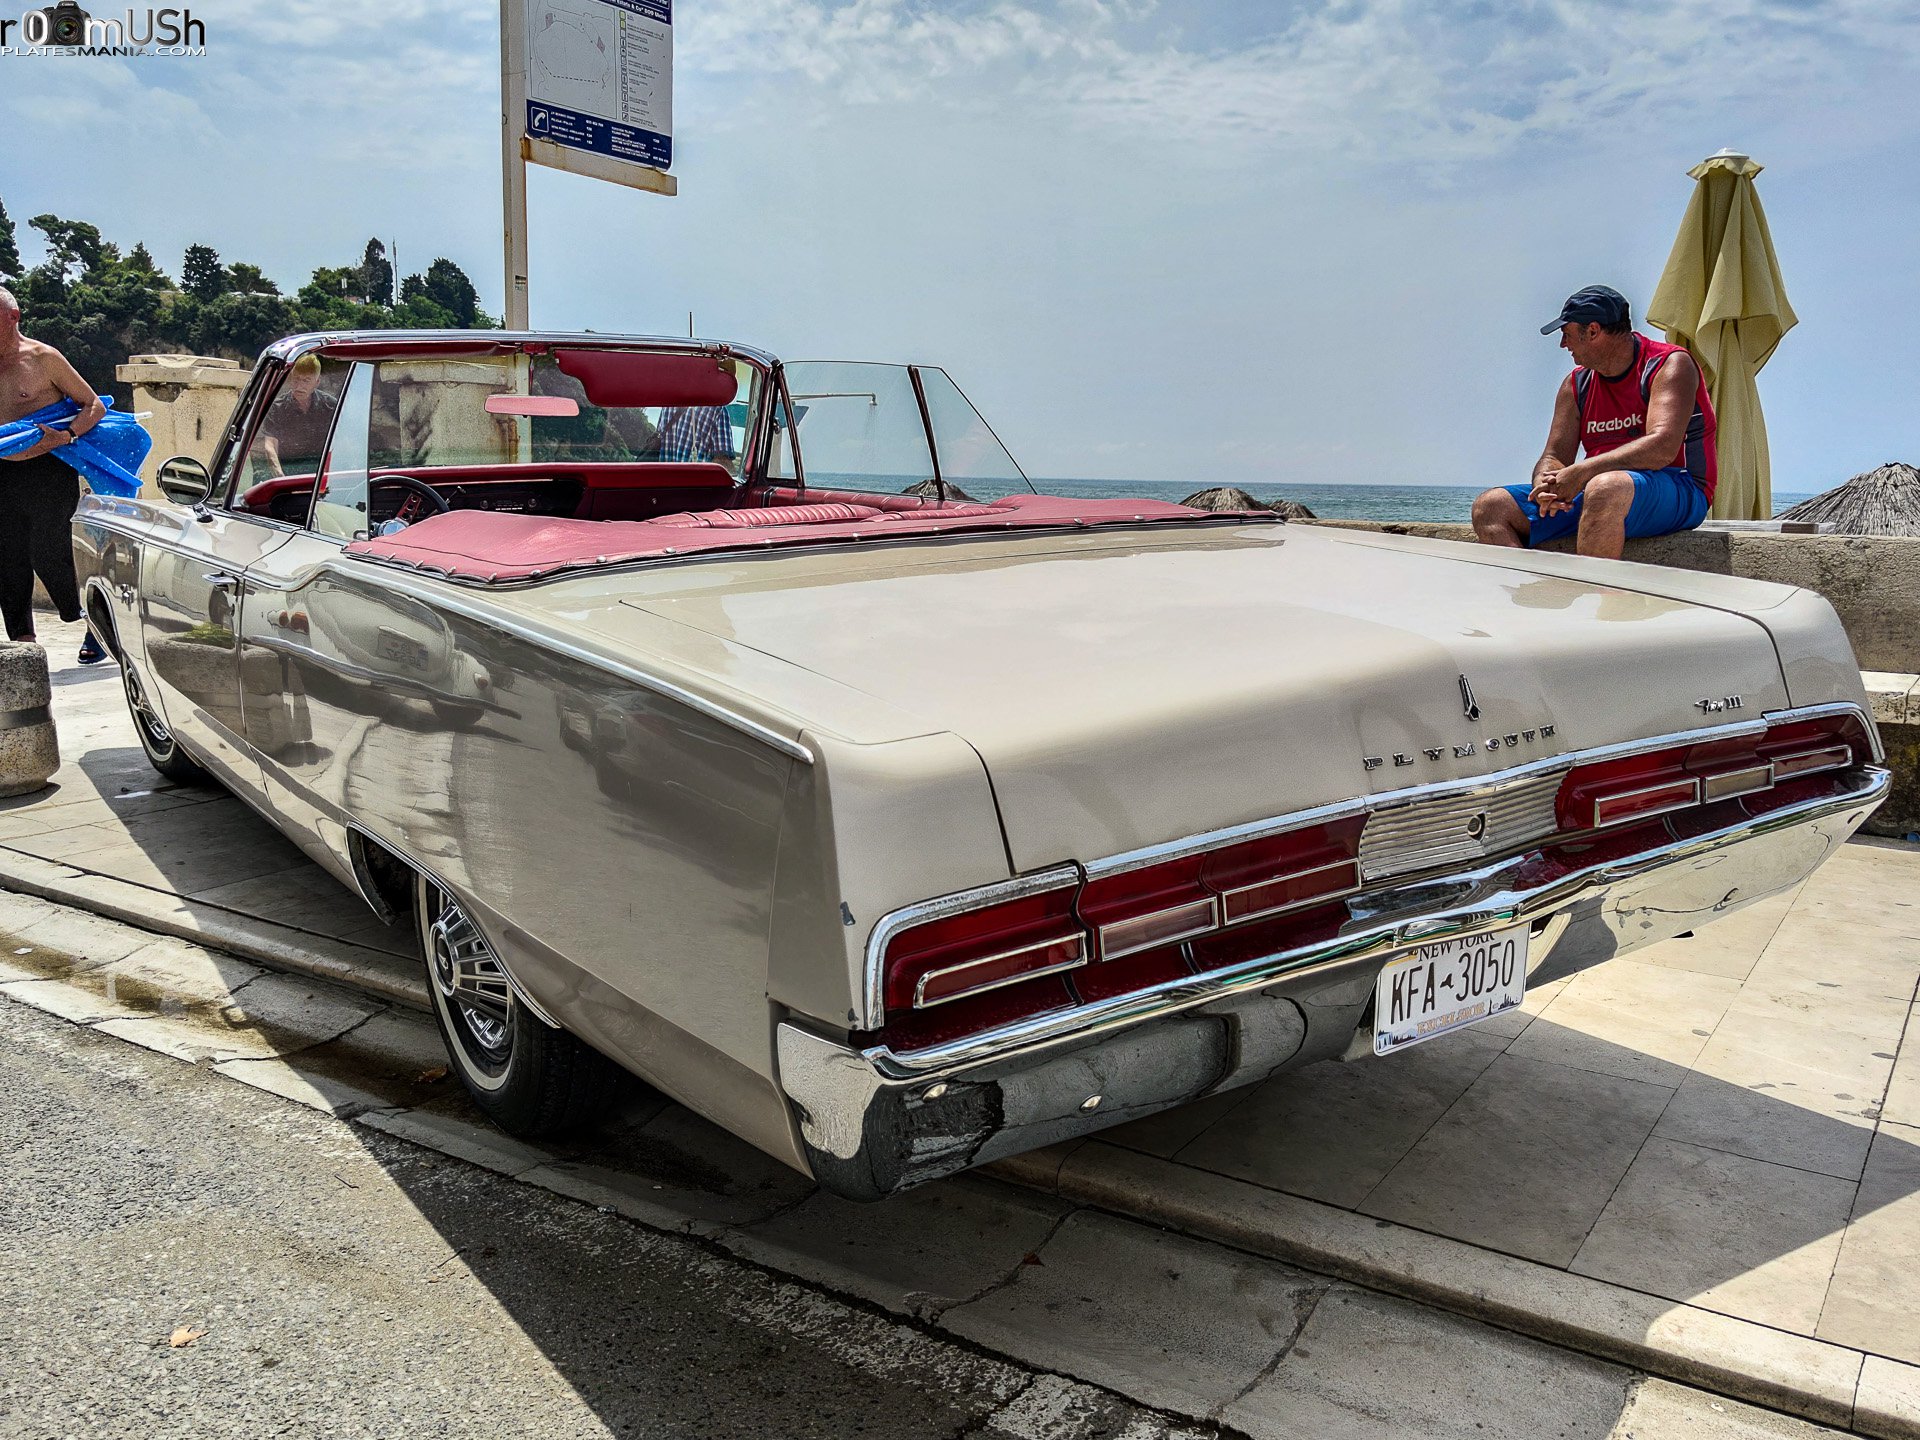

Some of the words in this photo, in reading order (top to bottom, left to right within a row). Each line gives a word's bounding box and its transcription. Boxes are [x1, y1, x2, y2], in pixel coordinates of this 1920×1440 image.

[1586, 413, 1643, 434] Reebok
[1363, 724, 1556, 770] PLYMOUTH
[1418, 940, 1453, 963] NEW
[1390, 961, 1435, 1025] KFA
[1455, 938, 1515, 1001] 3050
